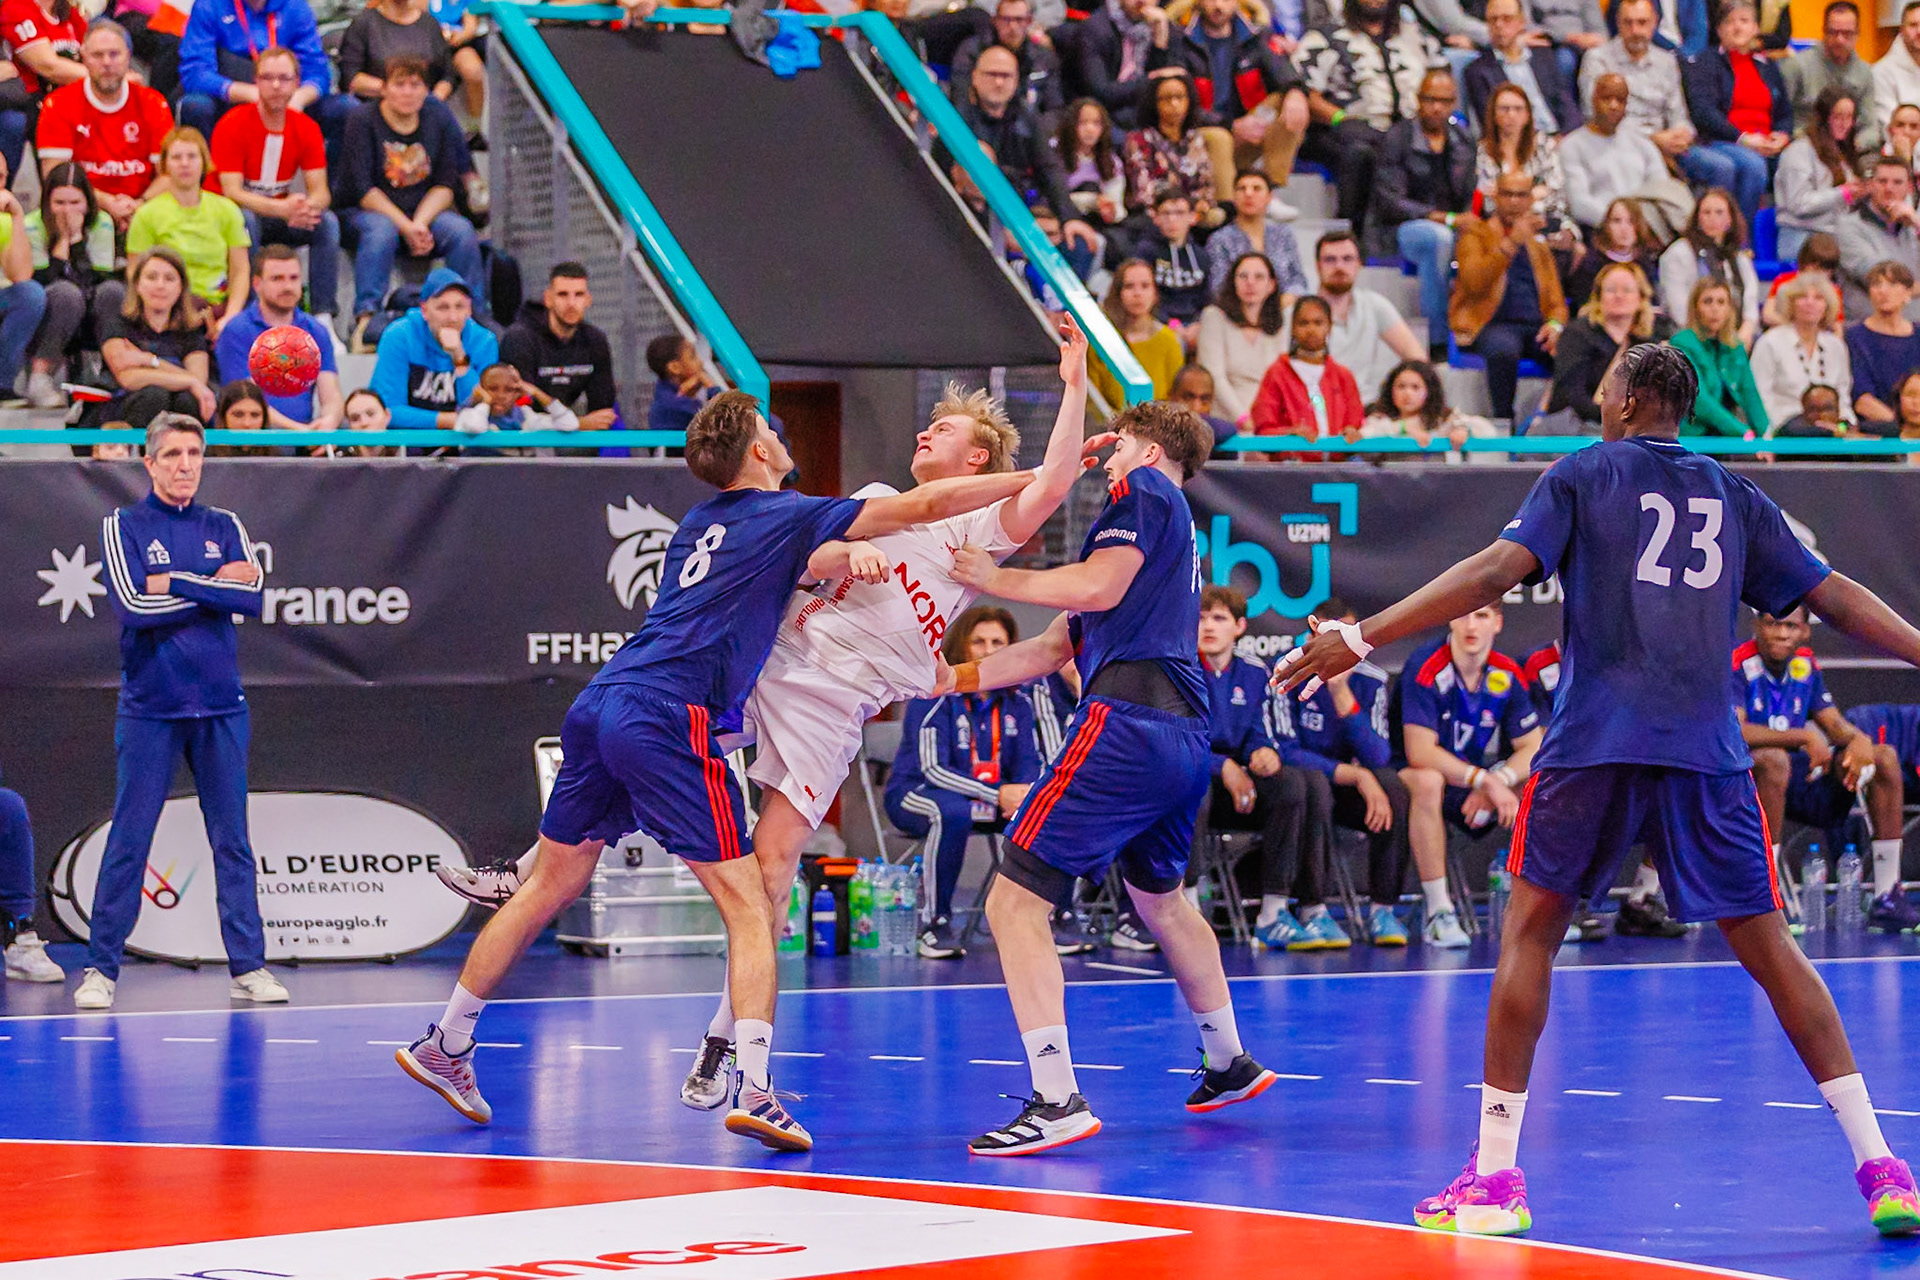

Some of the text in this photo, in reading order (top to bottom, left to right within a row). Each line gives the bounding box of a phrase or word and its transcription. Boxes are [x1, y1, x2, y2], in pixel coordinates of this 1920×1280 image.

[679, 523, 727, 588] 8
[1637, 492, 1723, 589] 23
[231, 586, 411, 625] rance
[894, 562, 947, 660] NOR
[527, 632, 637, 664] FFHa
[287, 854, 441, 874] D'EUROPE
[261, 915, 388, 930] europeagglo.fr
[370, 1241, 807, 1280] ance
